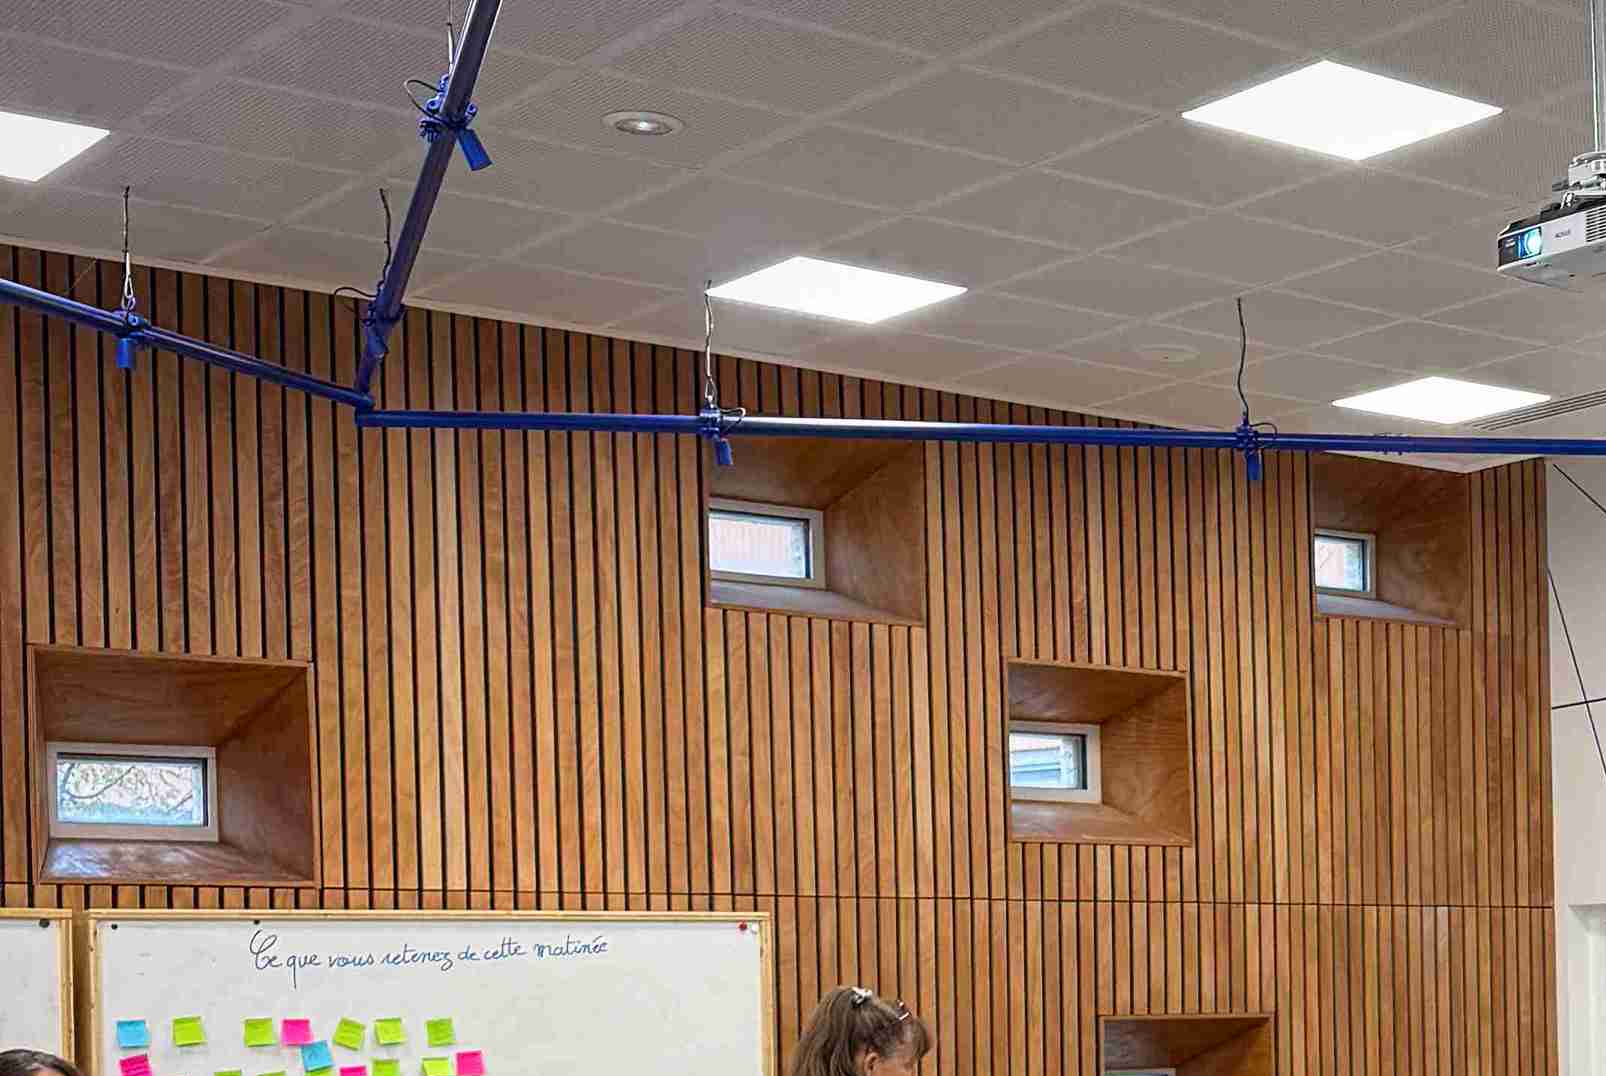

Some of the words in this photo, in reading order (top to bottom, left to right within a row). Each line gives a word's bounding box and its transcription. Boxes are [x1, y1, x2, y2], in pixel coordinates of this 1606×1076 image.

[249, 929, 283, 970] Ce
[286, 953, 321, 989] que
[328, 953, 375, 967] vous
[381, 943, 454, 972] retenez
[457, 945, 481, 961] de
[483, 936, 528, 960] cette
[533, 934, 609, 958] matinée
